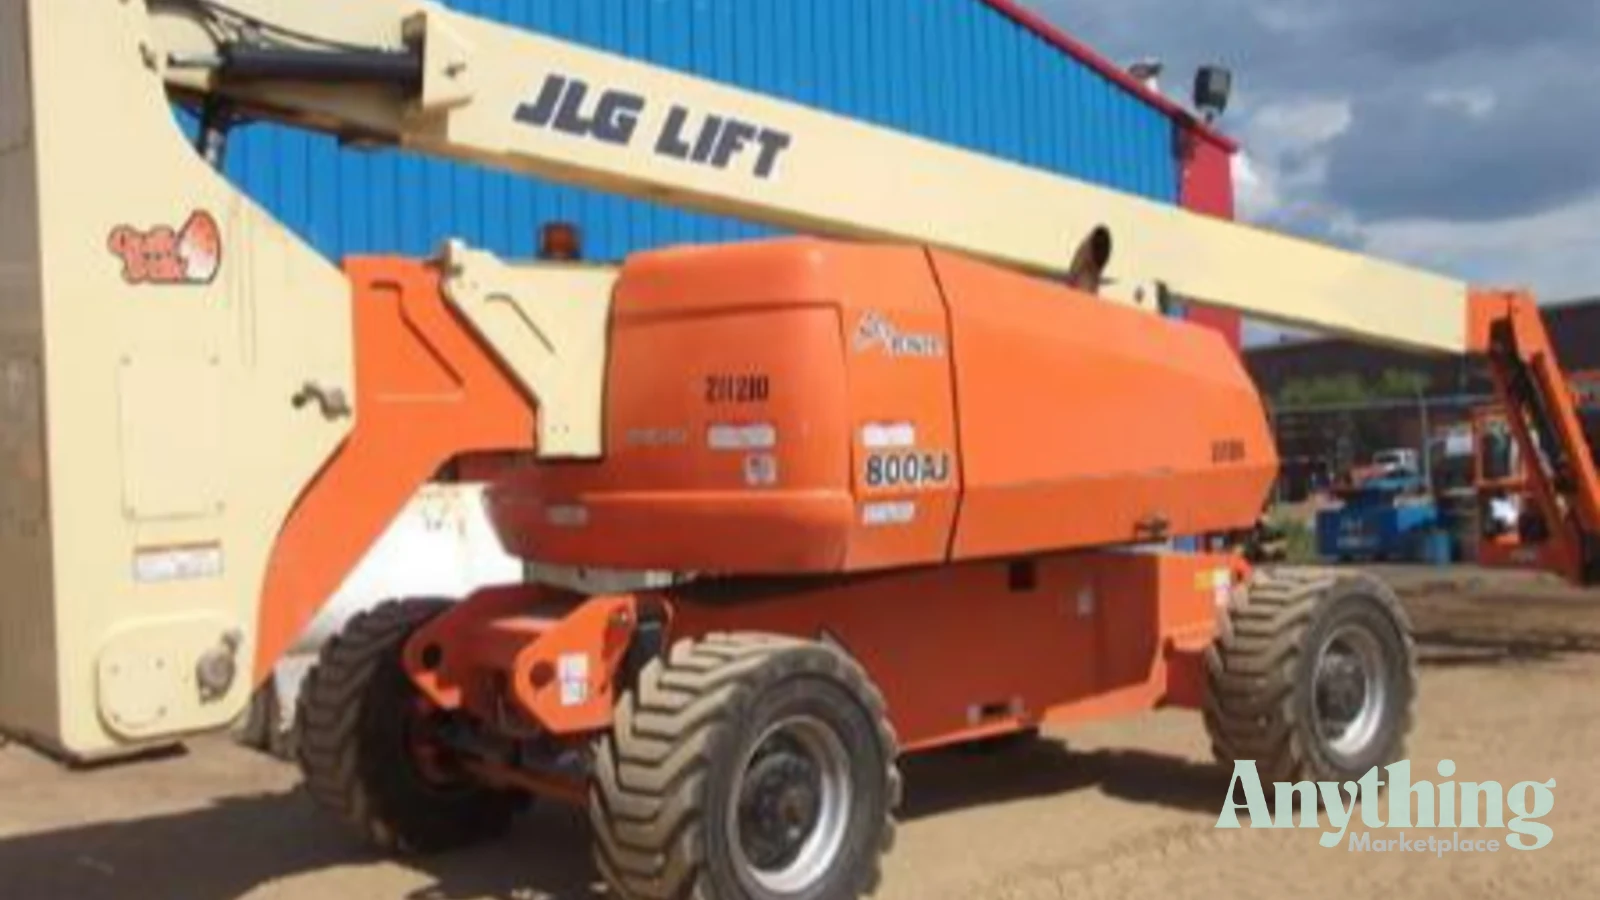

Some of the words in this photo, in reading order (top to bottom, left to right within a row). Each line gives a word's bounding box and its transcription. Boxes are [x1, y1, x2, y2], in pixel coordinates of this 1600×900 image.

[512, 73, 645, 146] JLG
[653, 104, 791, 179] LIFT
[865, 451, 950, 487] 800AJ
